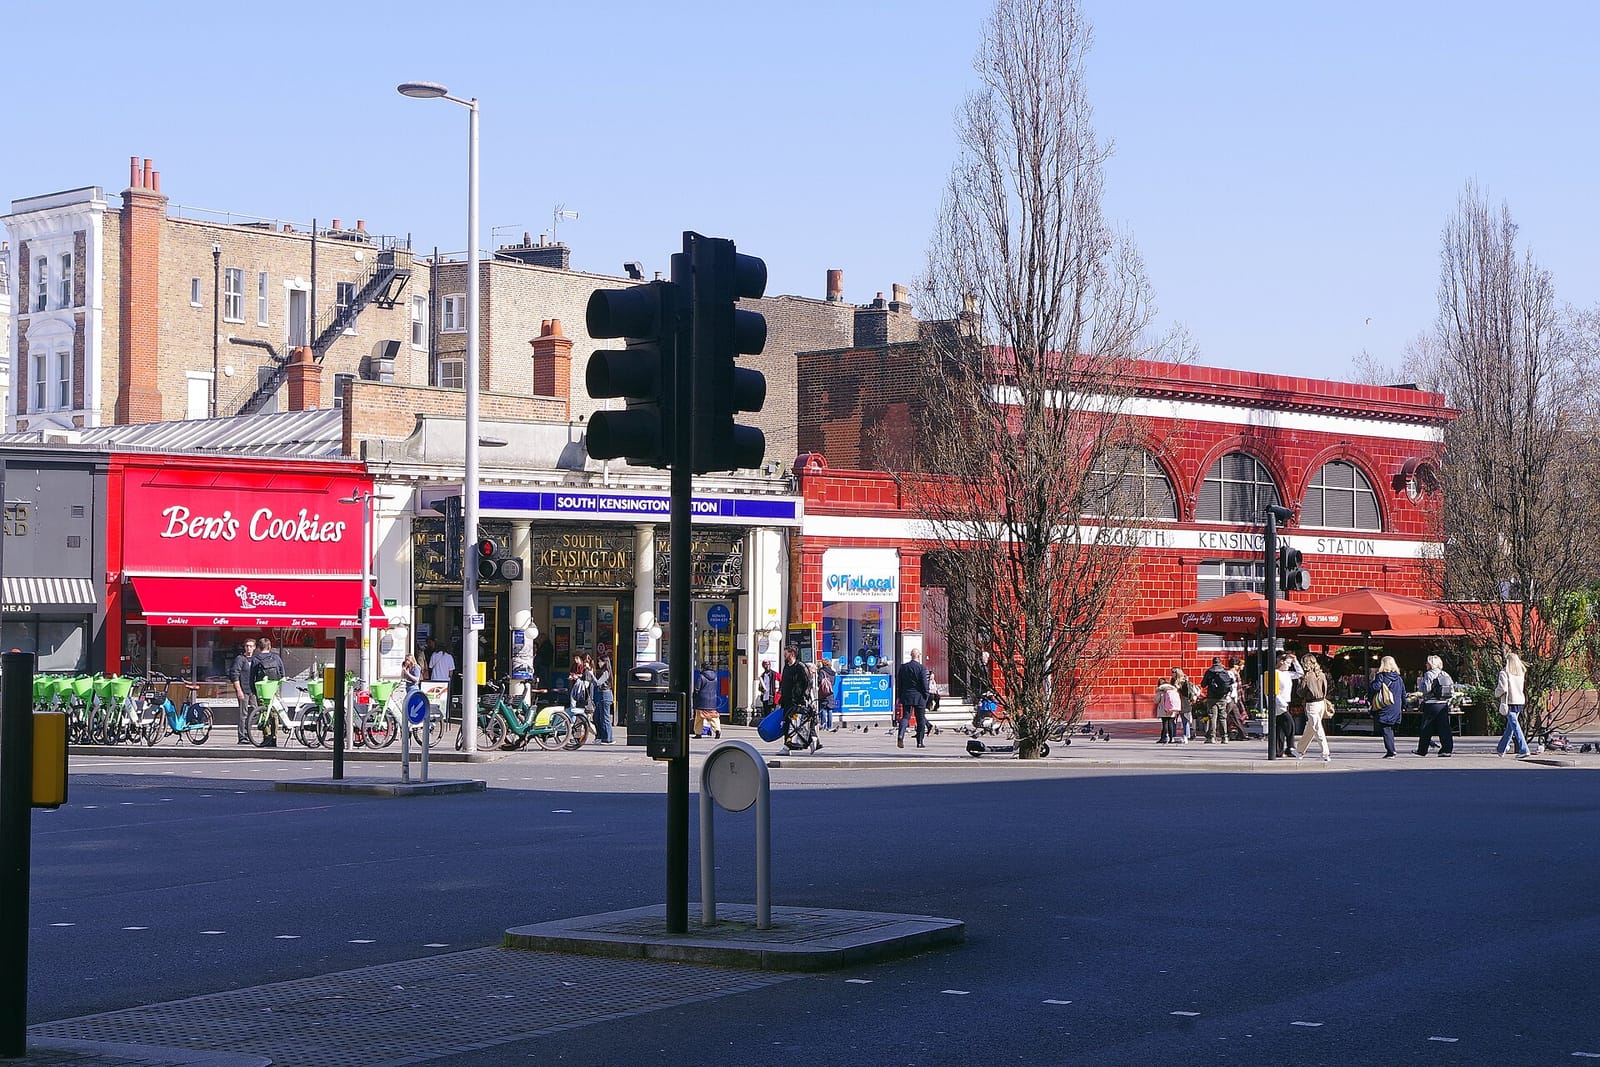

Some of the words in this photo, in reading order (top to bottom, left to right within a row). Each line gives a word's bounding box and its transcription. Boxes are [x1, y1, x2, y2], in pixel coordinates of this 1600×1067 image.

[558, 496, 596, 509] SOUTH
[600, 498, 670, 511] KENSINGTON
[691, 501, 718, 513] TION
[160, 505, 240, 541] Ben's
[249, 507, 347, 542] Cookies
[563, 534, 602, 548] SOUTH
[1101, 527, 1165, 546] SOUTH
[1198, 532, 1291, 550] KENSINGON
[1317, 538, 1375, 555] STATION
[541, 549, 625, 568] KENSINGTON
[556, 569, 611, 583] STATION
[2, 604, 31, 612] HEAD
[213, 617, 229, 625] Coffee
[1223, 615, 1232, 623] 020
